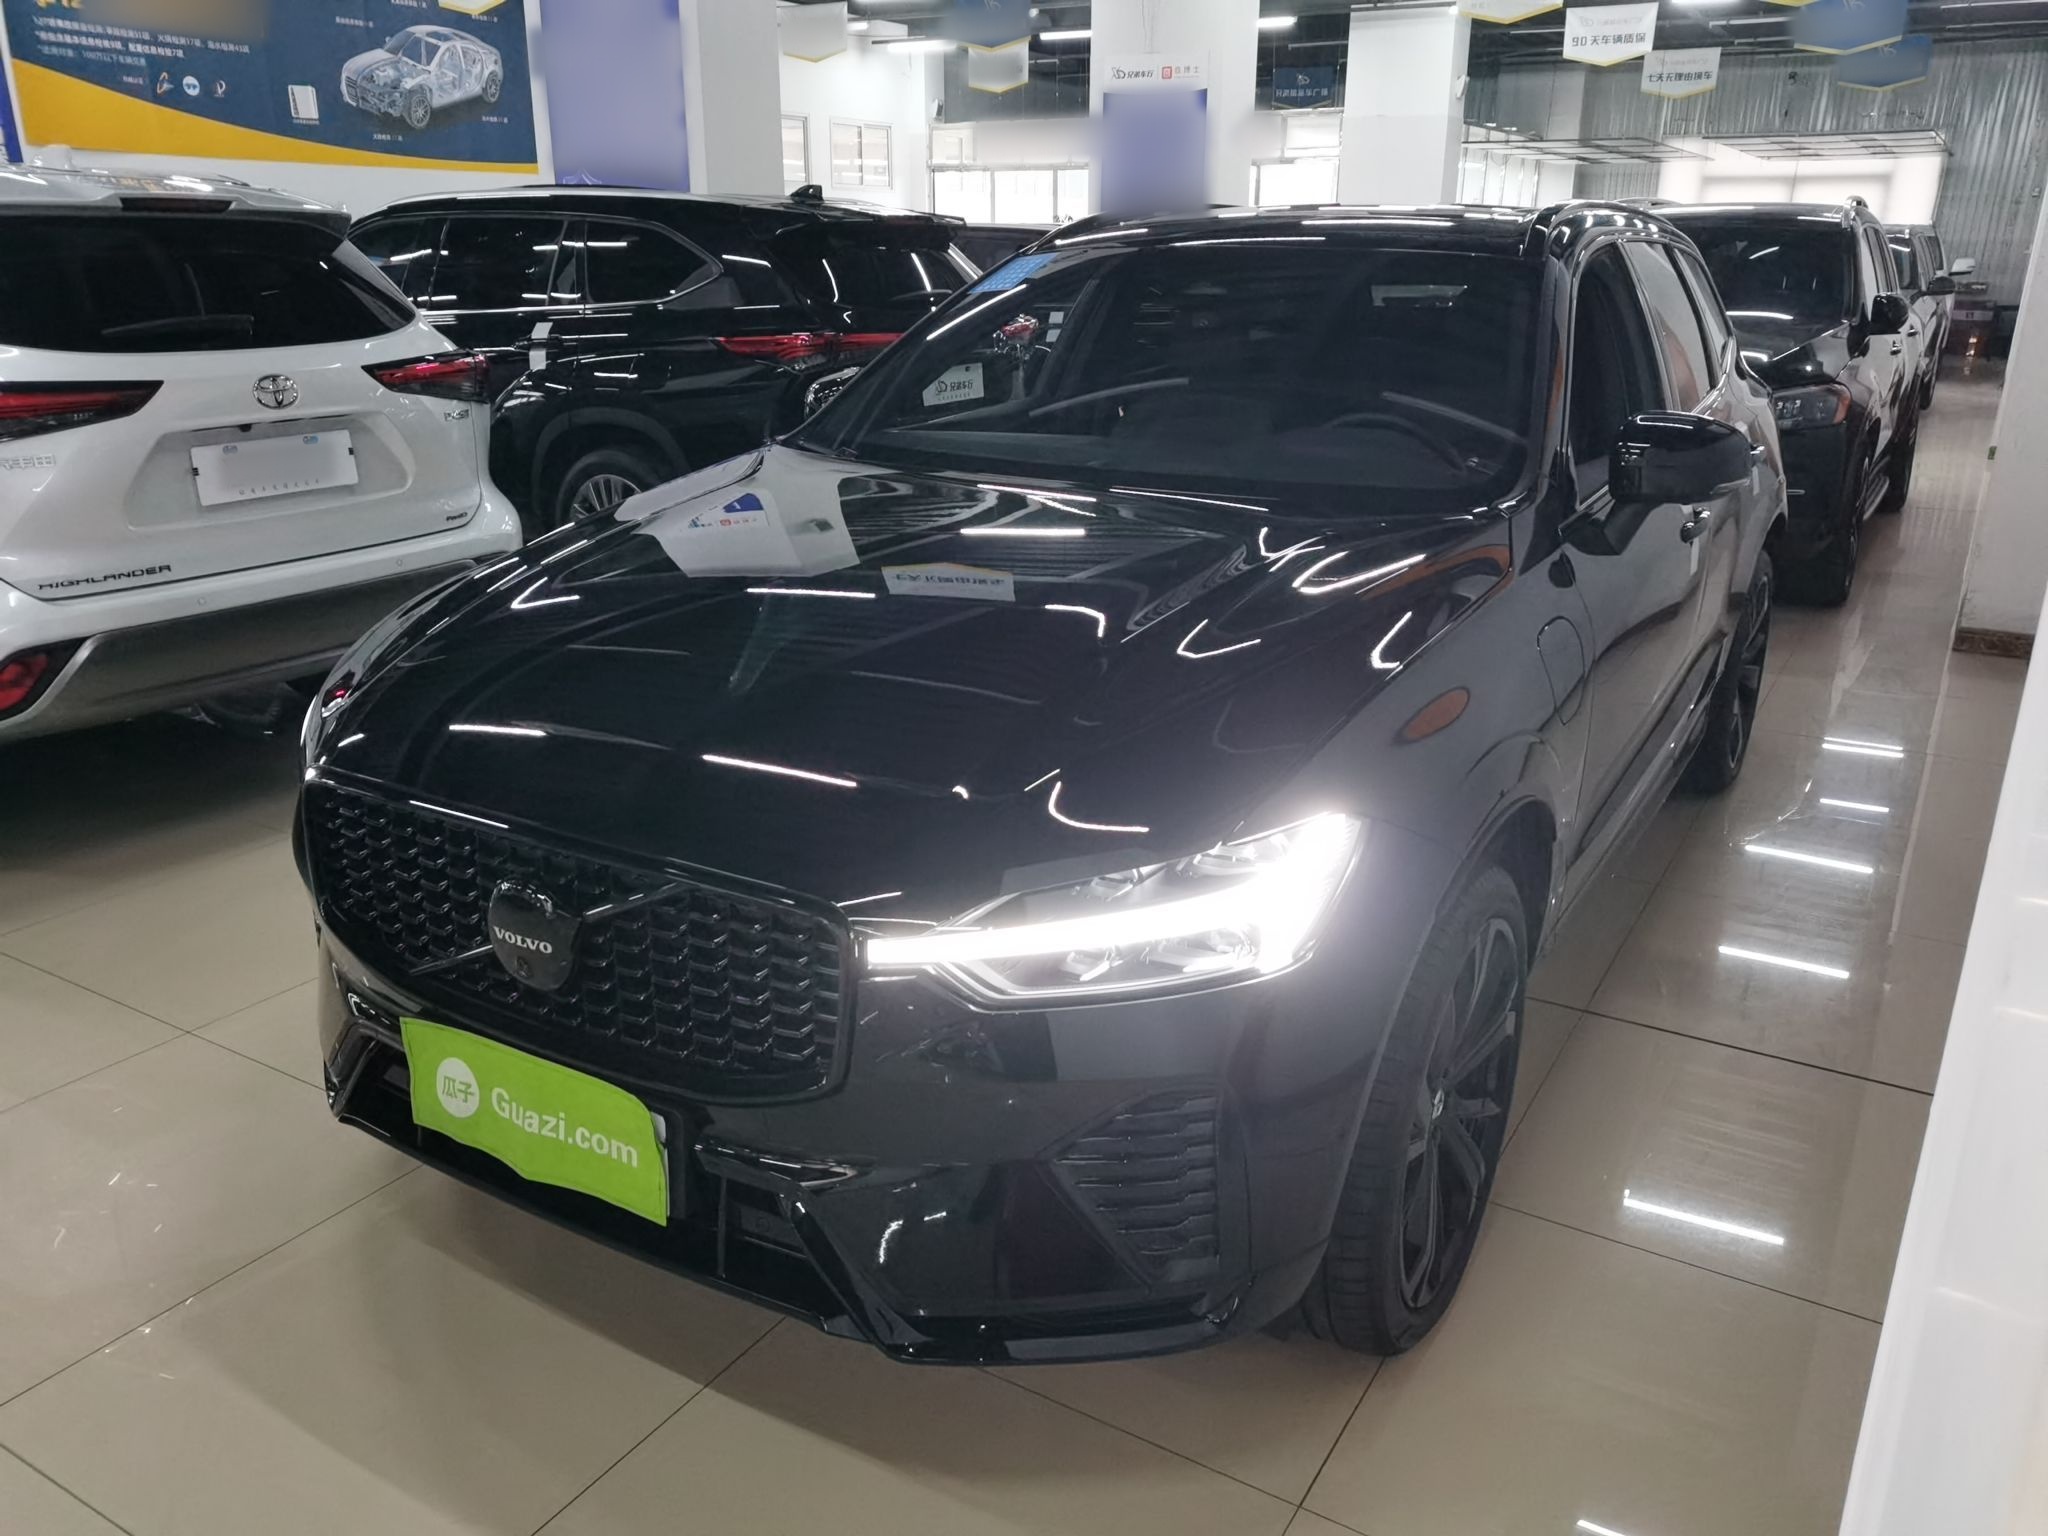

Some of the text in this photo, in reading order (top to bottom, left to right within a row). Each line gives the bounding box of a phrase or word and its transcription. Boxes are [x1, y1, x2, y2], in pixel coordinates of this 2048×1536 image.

[38, 564, 172, 591] HIGHLANDER
[493, 926, 553, 954] VOLVO
[442, 1075, 475, 1103] 瓜子
[491, 1087, 638, 1168] Guazi.com
